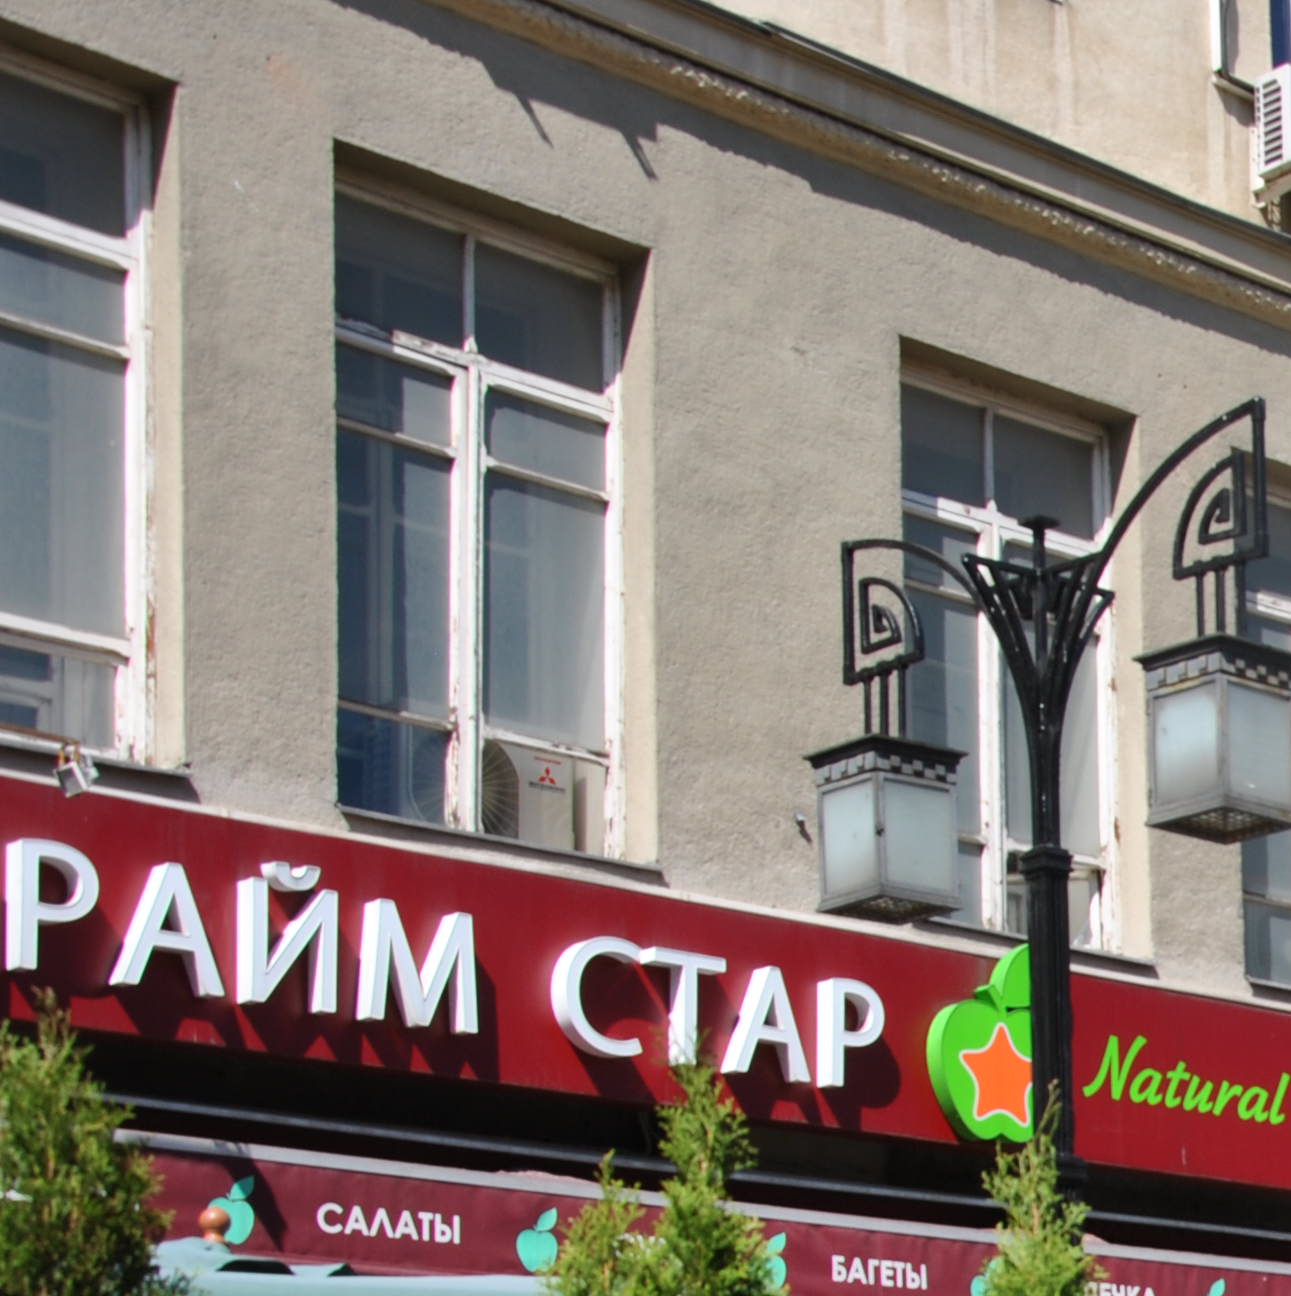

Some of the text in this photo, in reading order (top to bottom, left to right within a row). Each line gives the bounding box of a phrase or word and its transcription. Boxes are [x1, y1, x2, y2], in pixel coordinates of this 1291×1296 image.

[5, 838, 886, 1088] РАЙМ СТАР
[1083, 1034, 1289, 1126] Natural
[316, 1202, 461, 1245] САЛАТЫ
[831, 1254, 929, 1291] БАГЕТЫ
